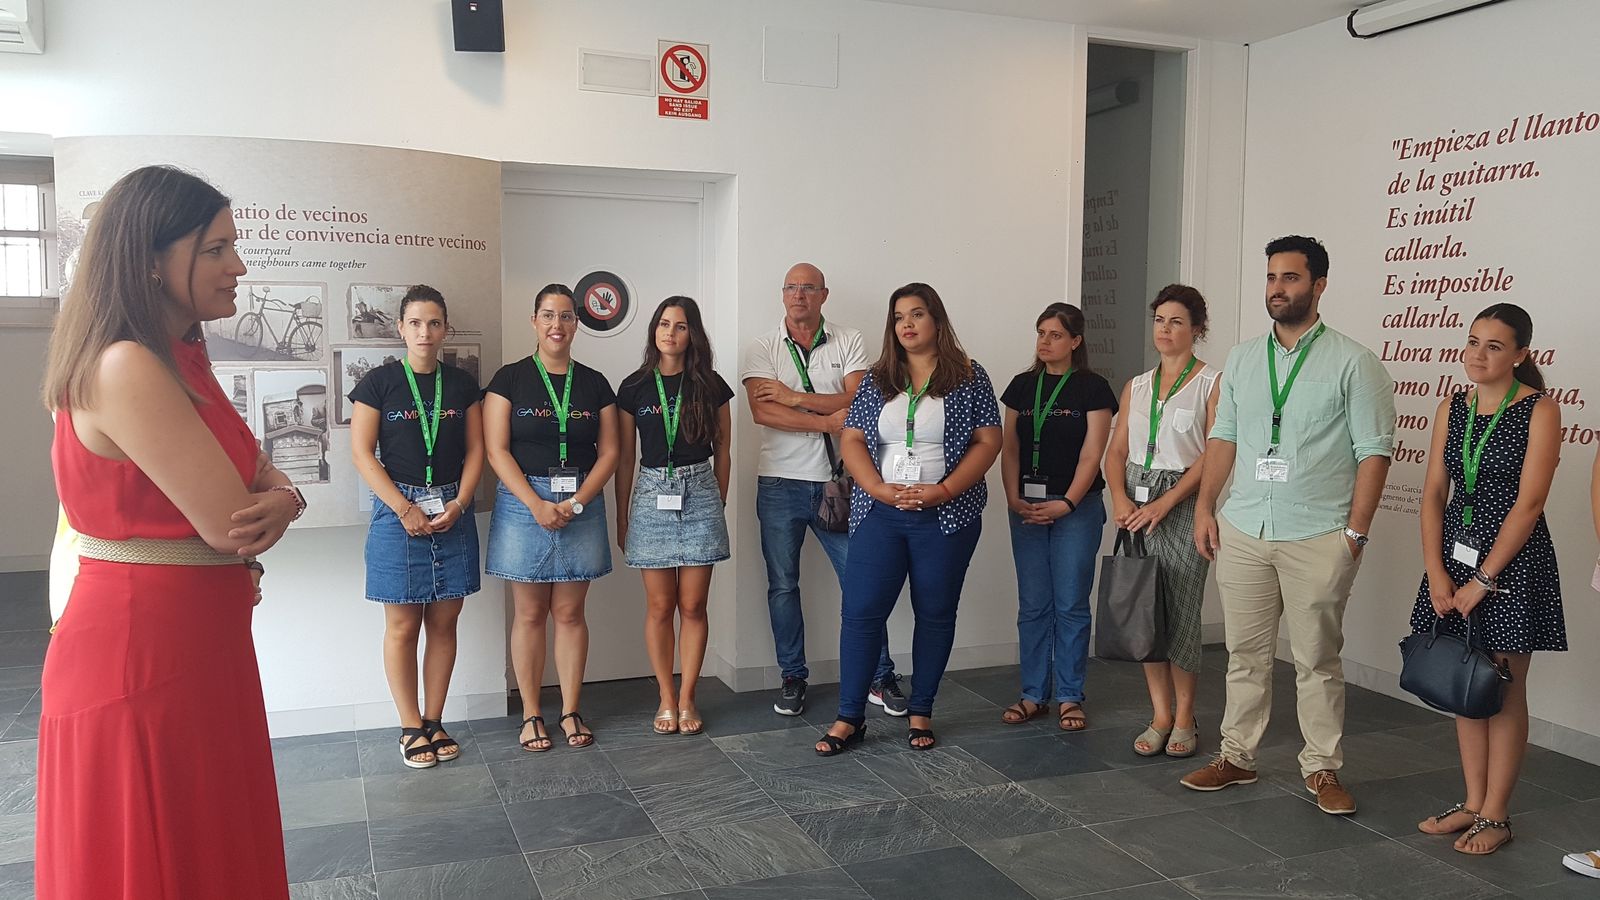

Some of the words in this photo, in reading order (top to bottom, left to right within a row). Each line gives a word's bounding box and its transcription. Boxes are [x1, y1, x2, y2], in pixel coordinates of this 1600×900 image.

[1392, 129, 1490, 163] "Empieza
[1496, 117, 1519, 145] el
[1523, 111, 1600, 141] llanto
[1387, 171, 1410, 196] de
[1415, 168, 1435, 192] la
[1439, 160, 1540, 196] guitarra.
[233, 203, 270, 220] atio
[275, 203, 297, 221] de
[303, 206, 368, 224] vecinos
[1386, 207, 1408, 229] Es
[1413, 196, 1476, 228] inútil
[243, 246, 292, 256] courtyard
[258, 223, 280, 240] de
[286, 226, 390, 244] convivencia
[394, 234, 435, 247] entre
[438, 234, 486, 251] vecinos
[1384, 234, 1467, 263] callarla.
[246, 256, 299, 270] neighbours
[301, 260, 327, 268] came
[329, 259, 367, 272] together
[1383, 274, 1405, 295] Es
[1410, 266, 1514, 301] imposible
[1382, 305, 1464, 329] callarla.
[1380, 340, 1433, 363] Llora
